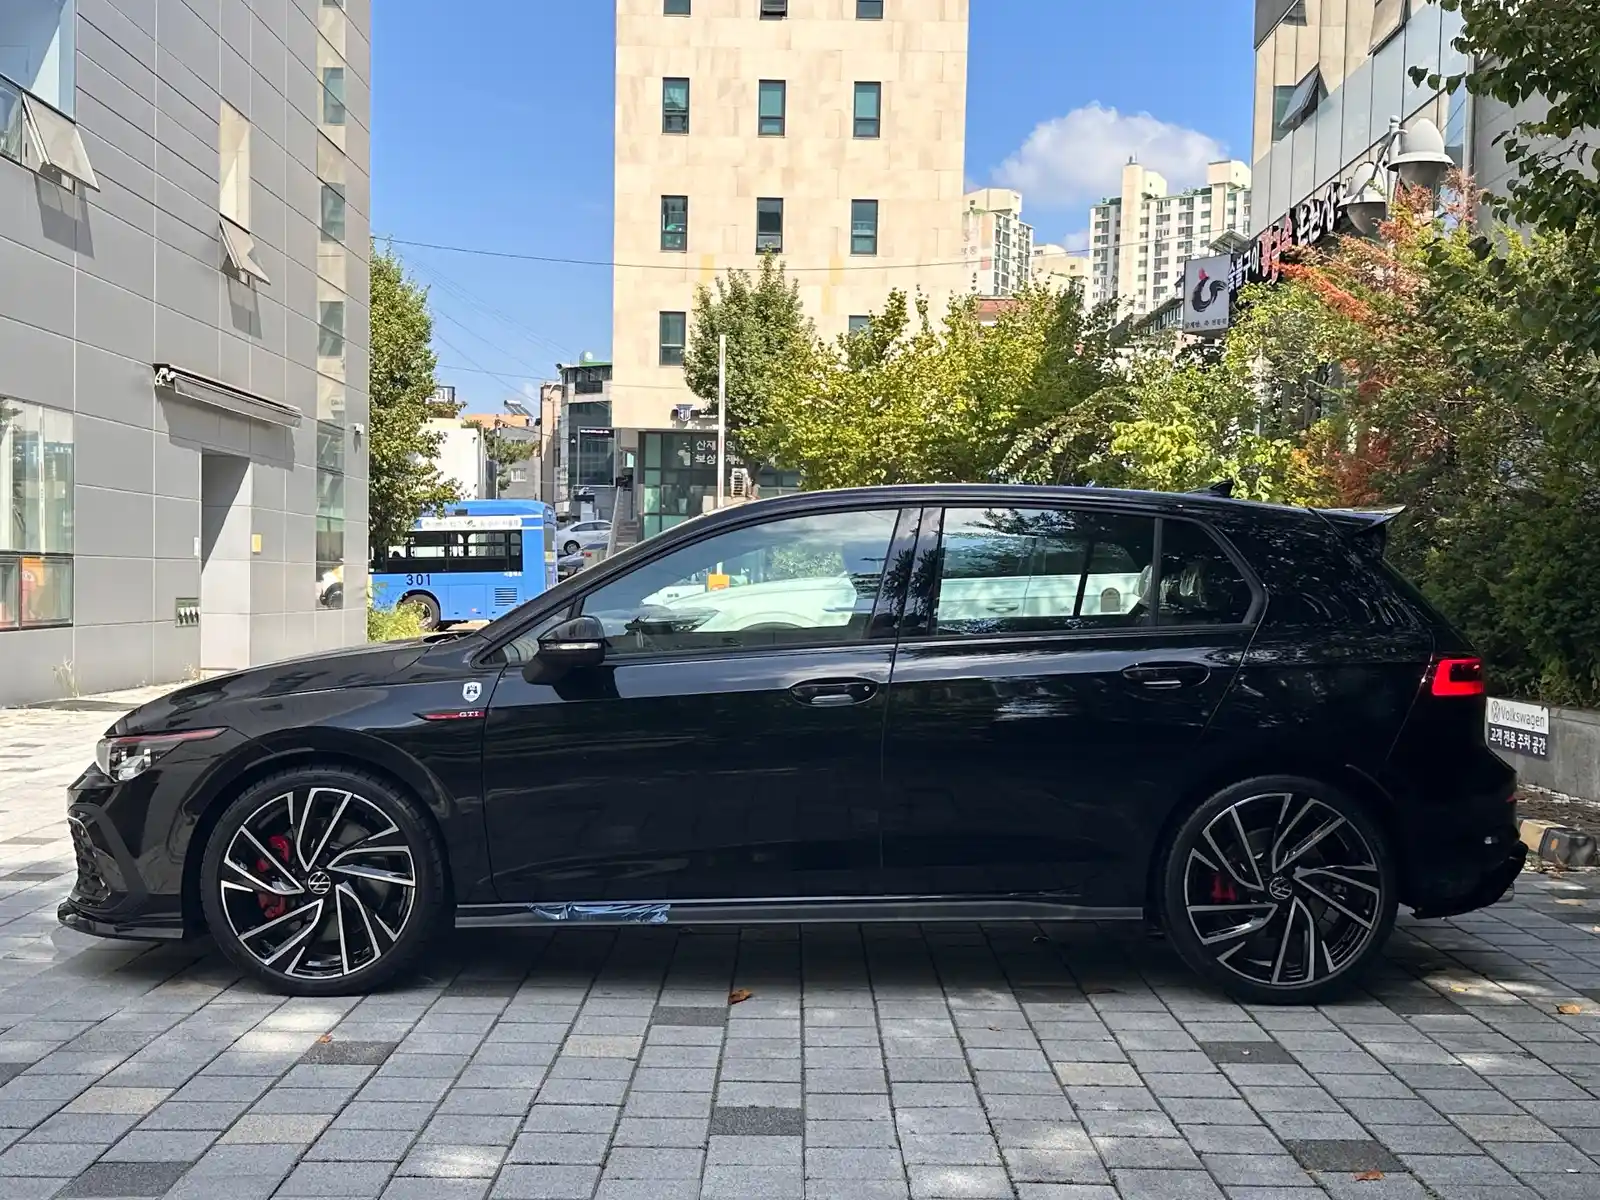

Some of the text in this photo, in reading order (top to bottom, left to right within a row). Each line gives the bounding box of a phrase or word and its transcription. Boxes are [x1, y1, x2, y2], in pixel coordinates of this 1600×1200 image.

[406, 573, 431, 586] 301
[1500, 705, 1545, 729] Volkswagen
[1490, 727, 1546, 755] 고객 전용 주차 공간
